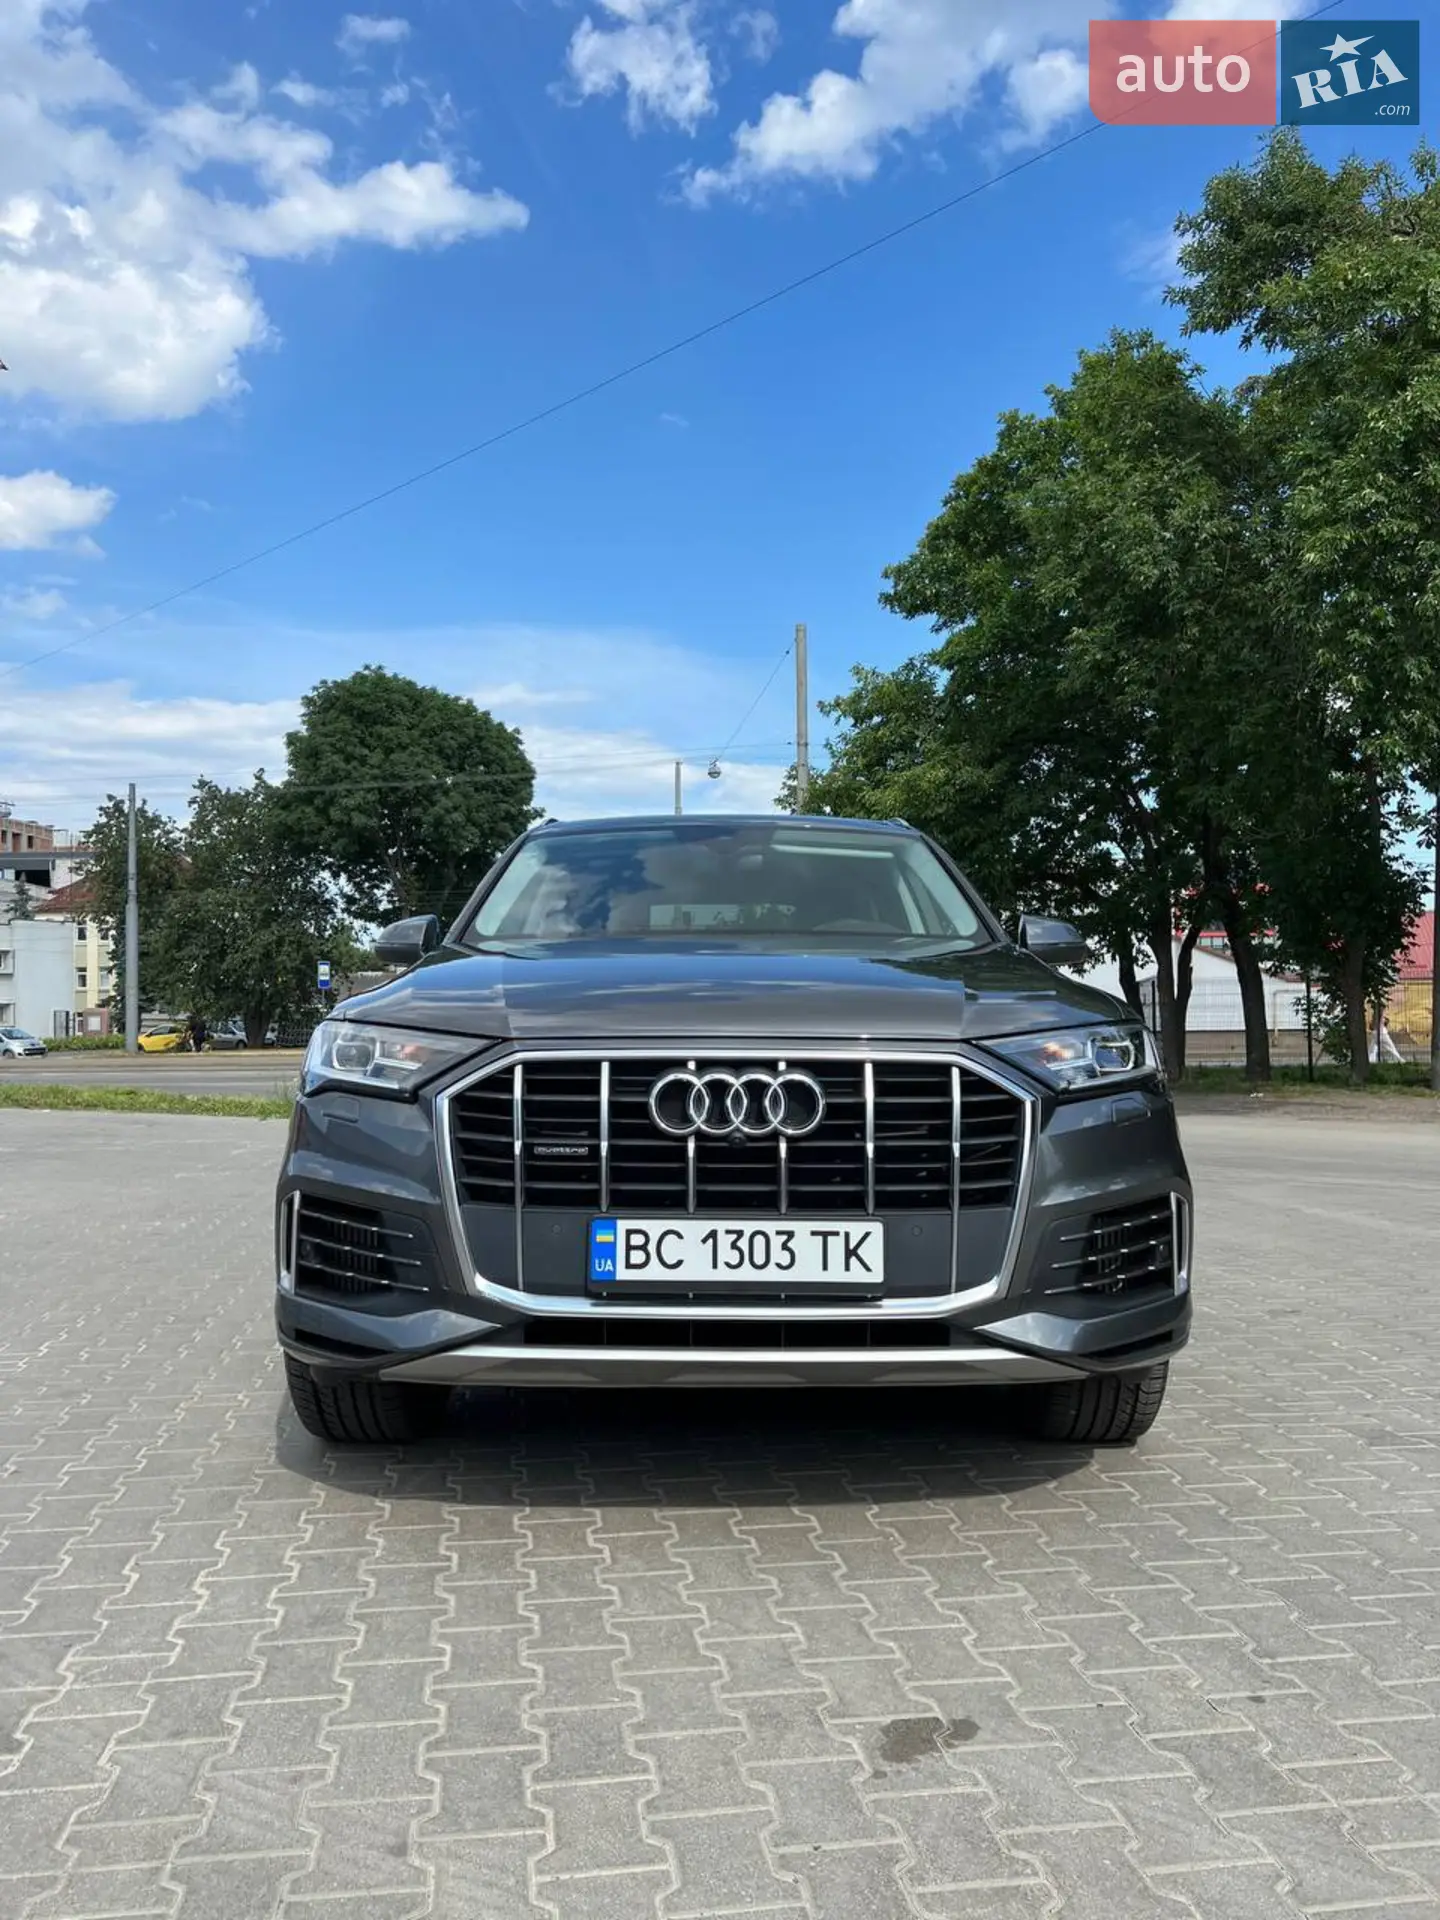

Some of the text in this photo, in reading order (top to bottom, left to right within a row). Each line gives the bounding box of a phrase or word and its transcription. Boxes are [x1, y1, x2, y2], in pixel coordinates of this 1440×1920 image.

[625, 1229, 873, 1272] BC 1303 TK
[595, 1259, 614, 1272] UA
